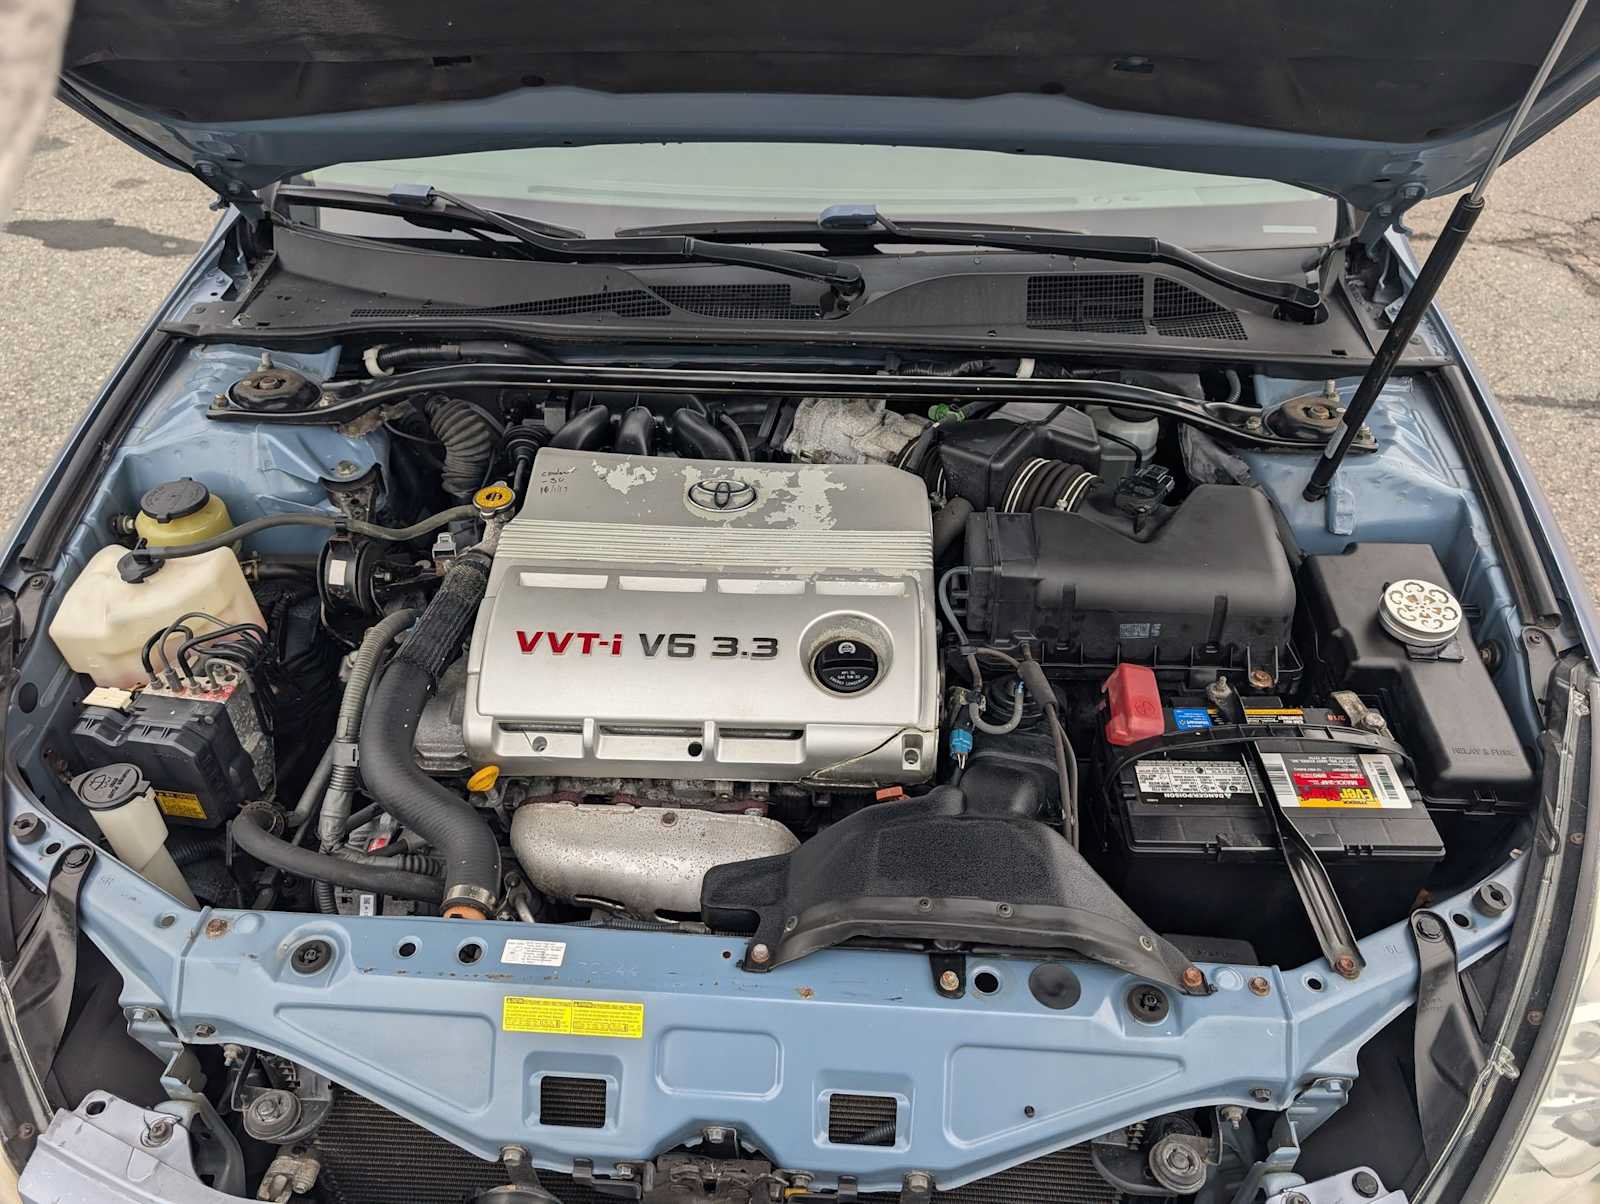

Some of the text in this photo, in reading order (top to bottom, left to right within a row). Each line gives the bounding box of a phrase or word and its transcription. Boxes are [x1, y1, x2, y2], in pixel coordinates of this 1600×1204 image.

[516, 630, 779, 660] VVT-i V6 3.3
